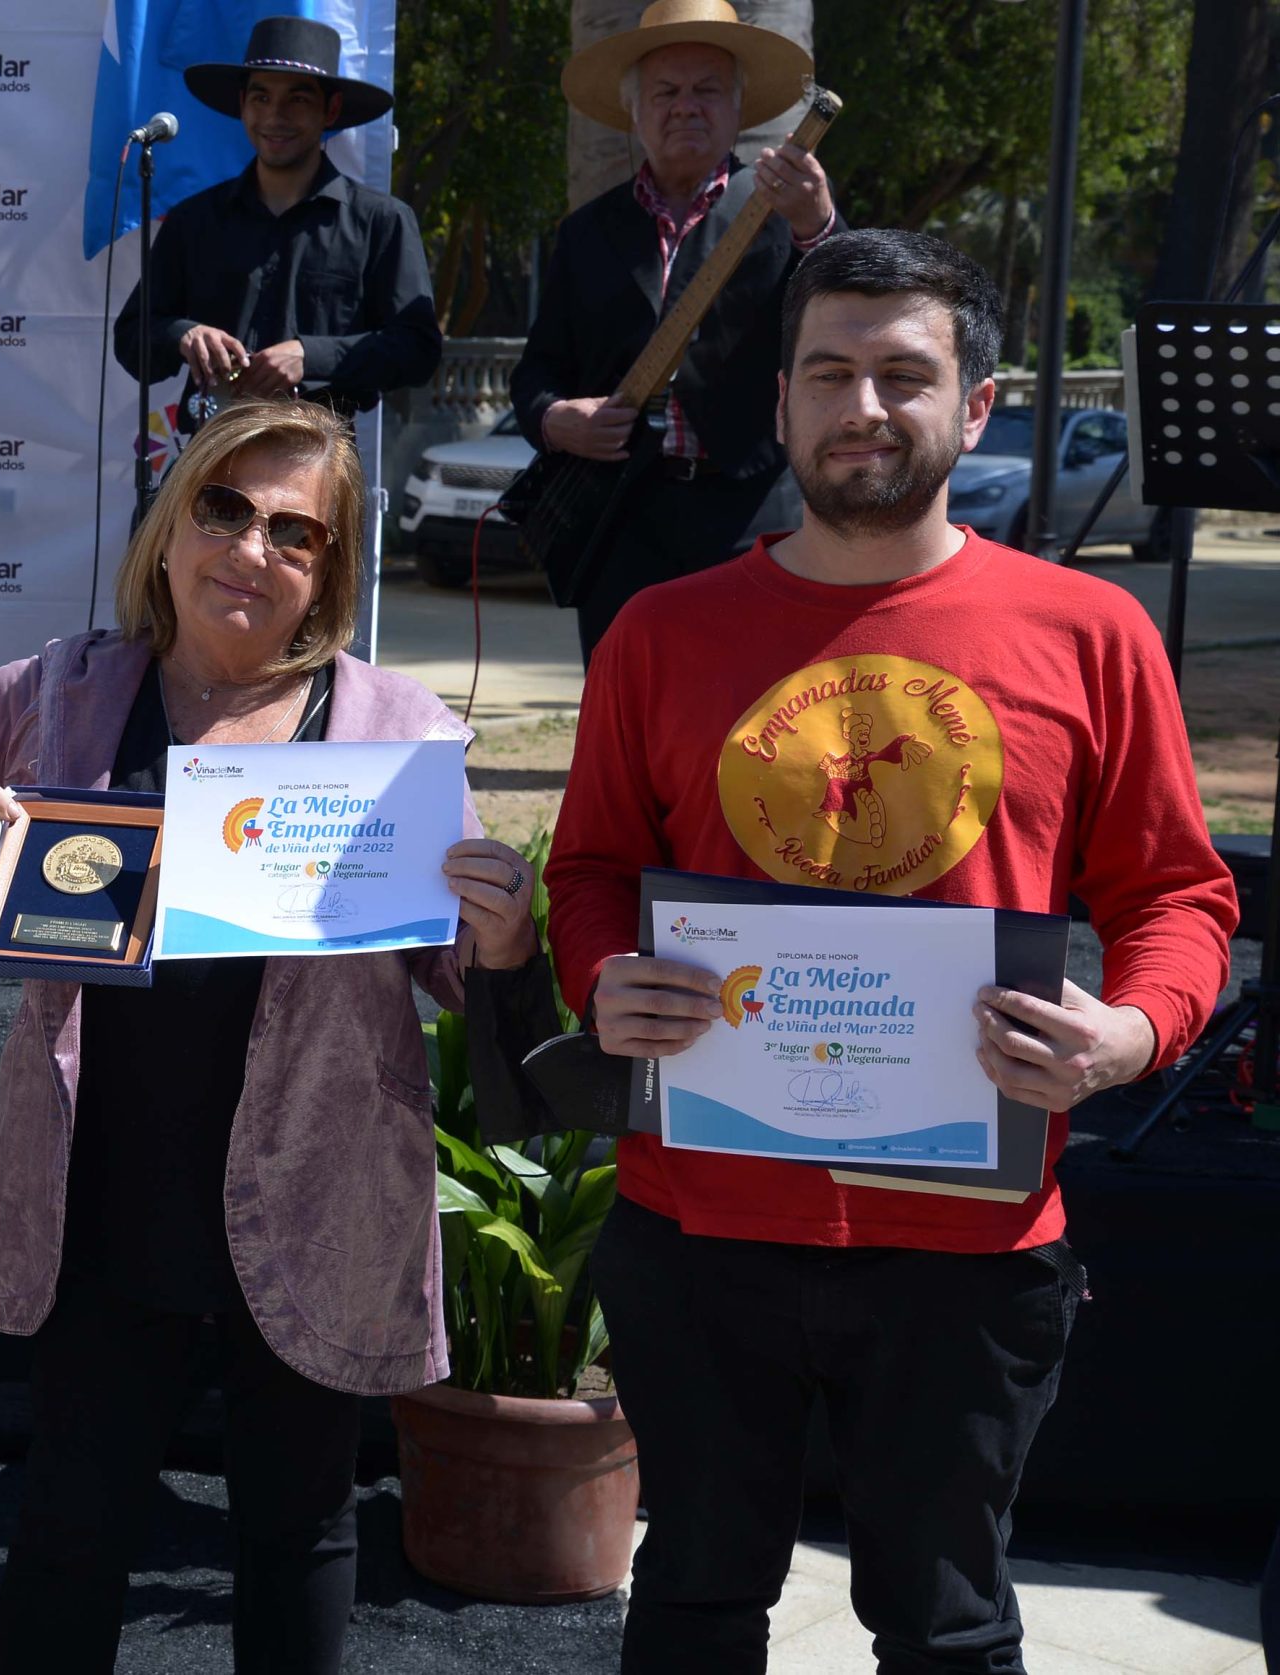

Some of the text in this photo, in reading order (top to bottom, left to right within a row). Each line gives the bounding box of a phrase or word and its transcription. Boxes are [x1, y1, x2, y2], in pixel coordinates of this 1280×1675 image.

[741, 667, 894, 764] Empanadas
[267, 794, 376, 818] La Mejor
[267, 818, 396, 842] Empanada
[265, 842, 395, 855] de Viña del Mar 2022
[274, 862, 301, 873] lugar
[333, 862, 364, 871] Horno
[775, 831, 944, 891] Receta Familiar
[333, 870, 389, 880] Vegetariana
[777, 952, 814, 960] DIPLOMA
[766, 966, 891, 993] La Mejor
[767, 993, 916, 1020] Empanada
[767, 1019, 915, 1036] de Viña del Mar 2022
[779, 1042, 810, 1054] lugar
[846, 1044, 882, 1054] Horno
[846, 1054, 911, 1065] Vegetariana
